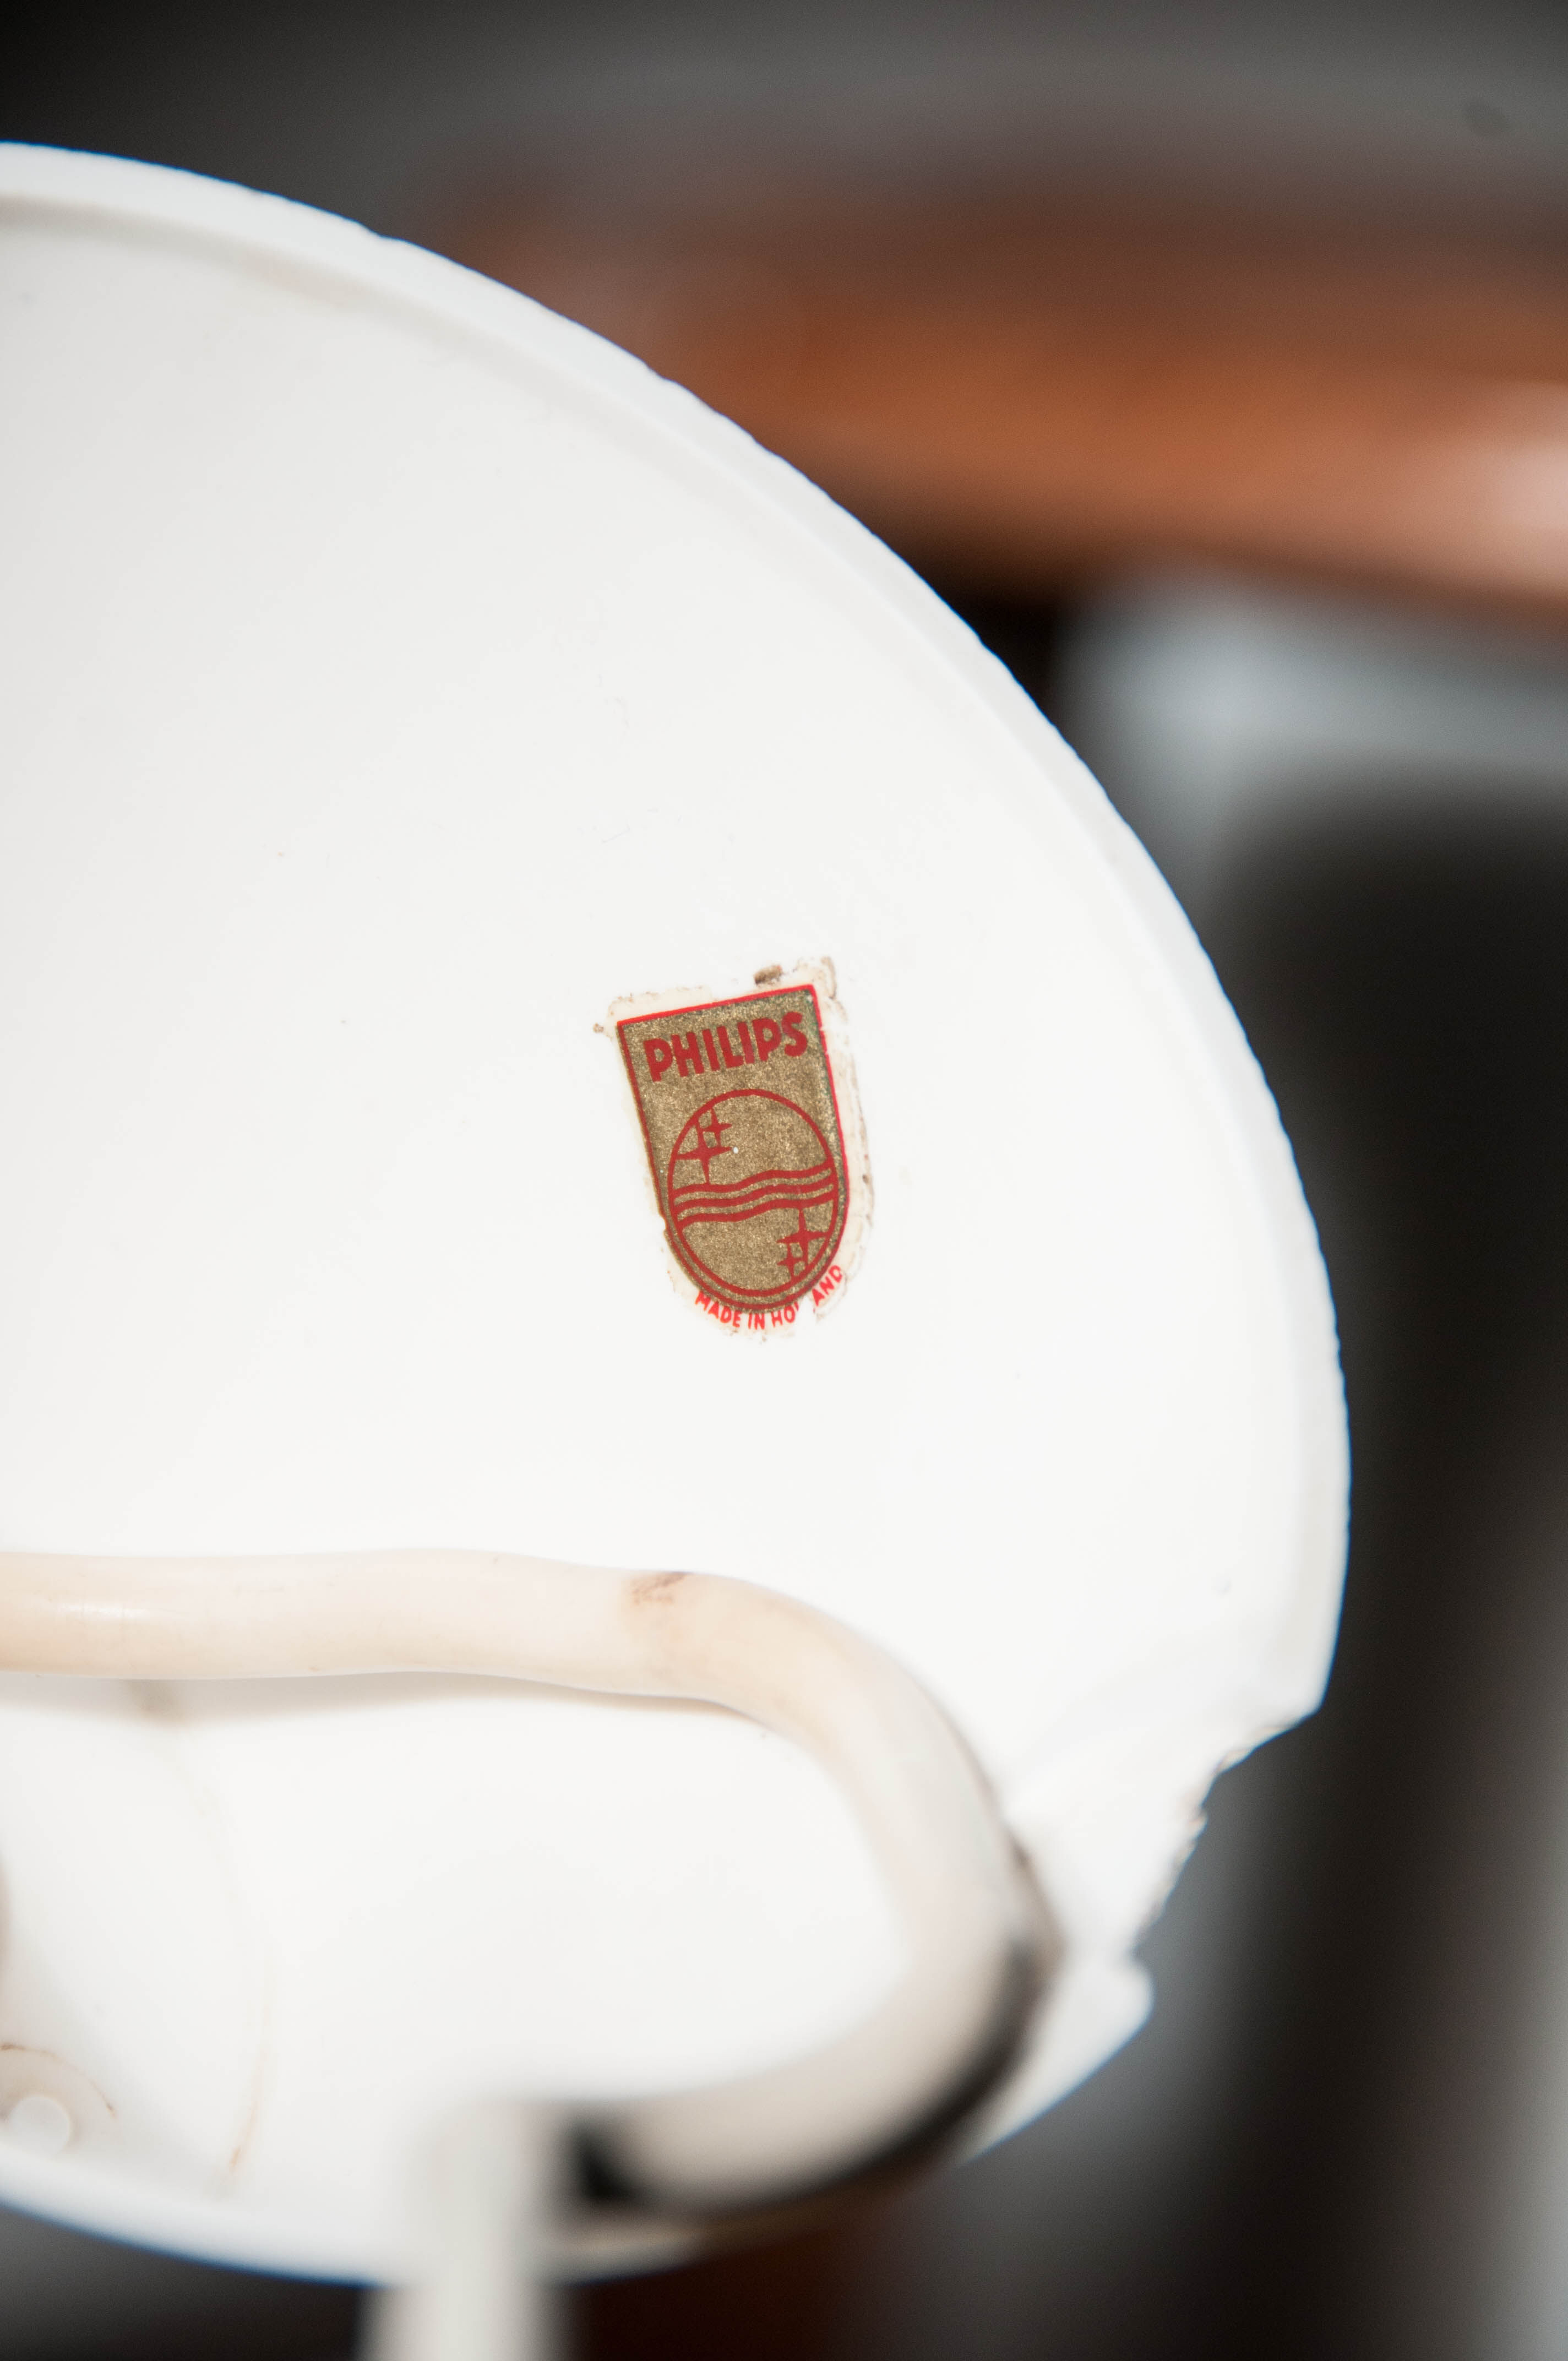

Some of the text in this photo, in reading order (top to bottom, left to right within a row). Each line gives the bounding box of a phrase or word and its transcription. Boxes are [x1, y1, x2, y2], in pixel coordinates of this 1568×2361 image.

[643, 1011, 808, 1082] PHILIPS
[694, 1265, 843, 1330] MADE IN HOAND
